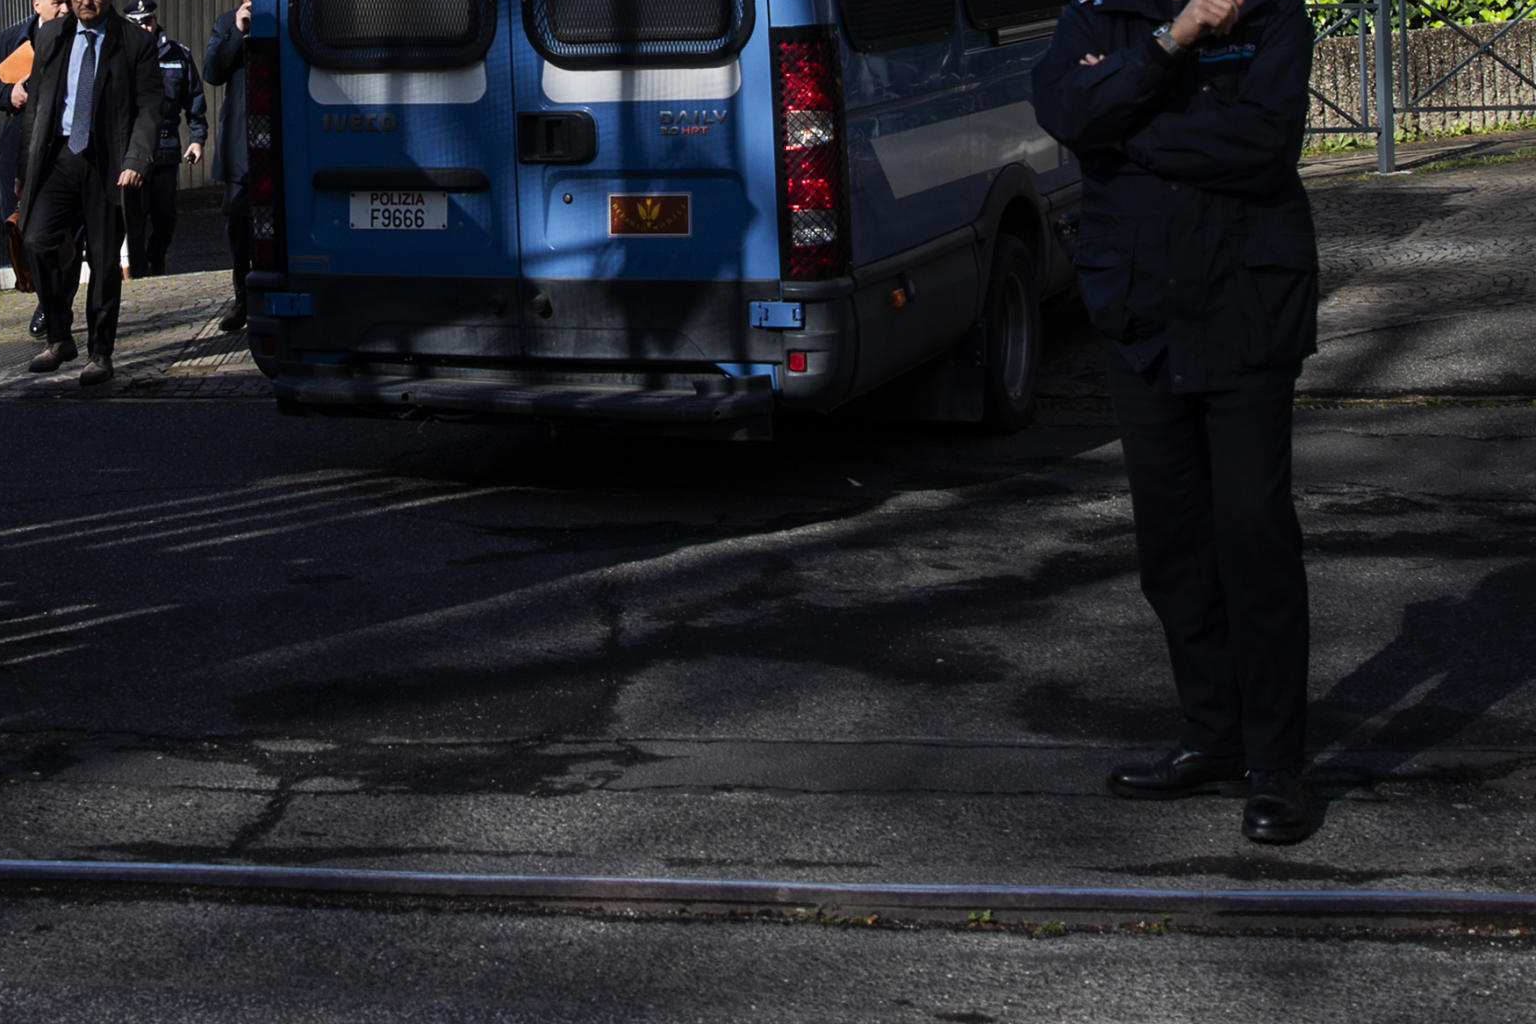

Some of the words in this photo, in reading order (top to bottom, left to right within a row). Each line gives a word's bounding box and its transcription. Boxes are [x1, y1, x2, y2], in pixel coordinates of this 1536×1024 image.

[322, 113, 399, 132] IVECO
[370, 192, 425, 206] POLIZIA
[370, 209, 425, 228] F9666
